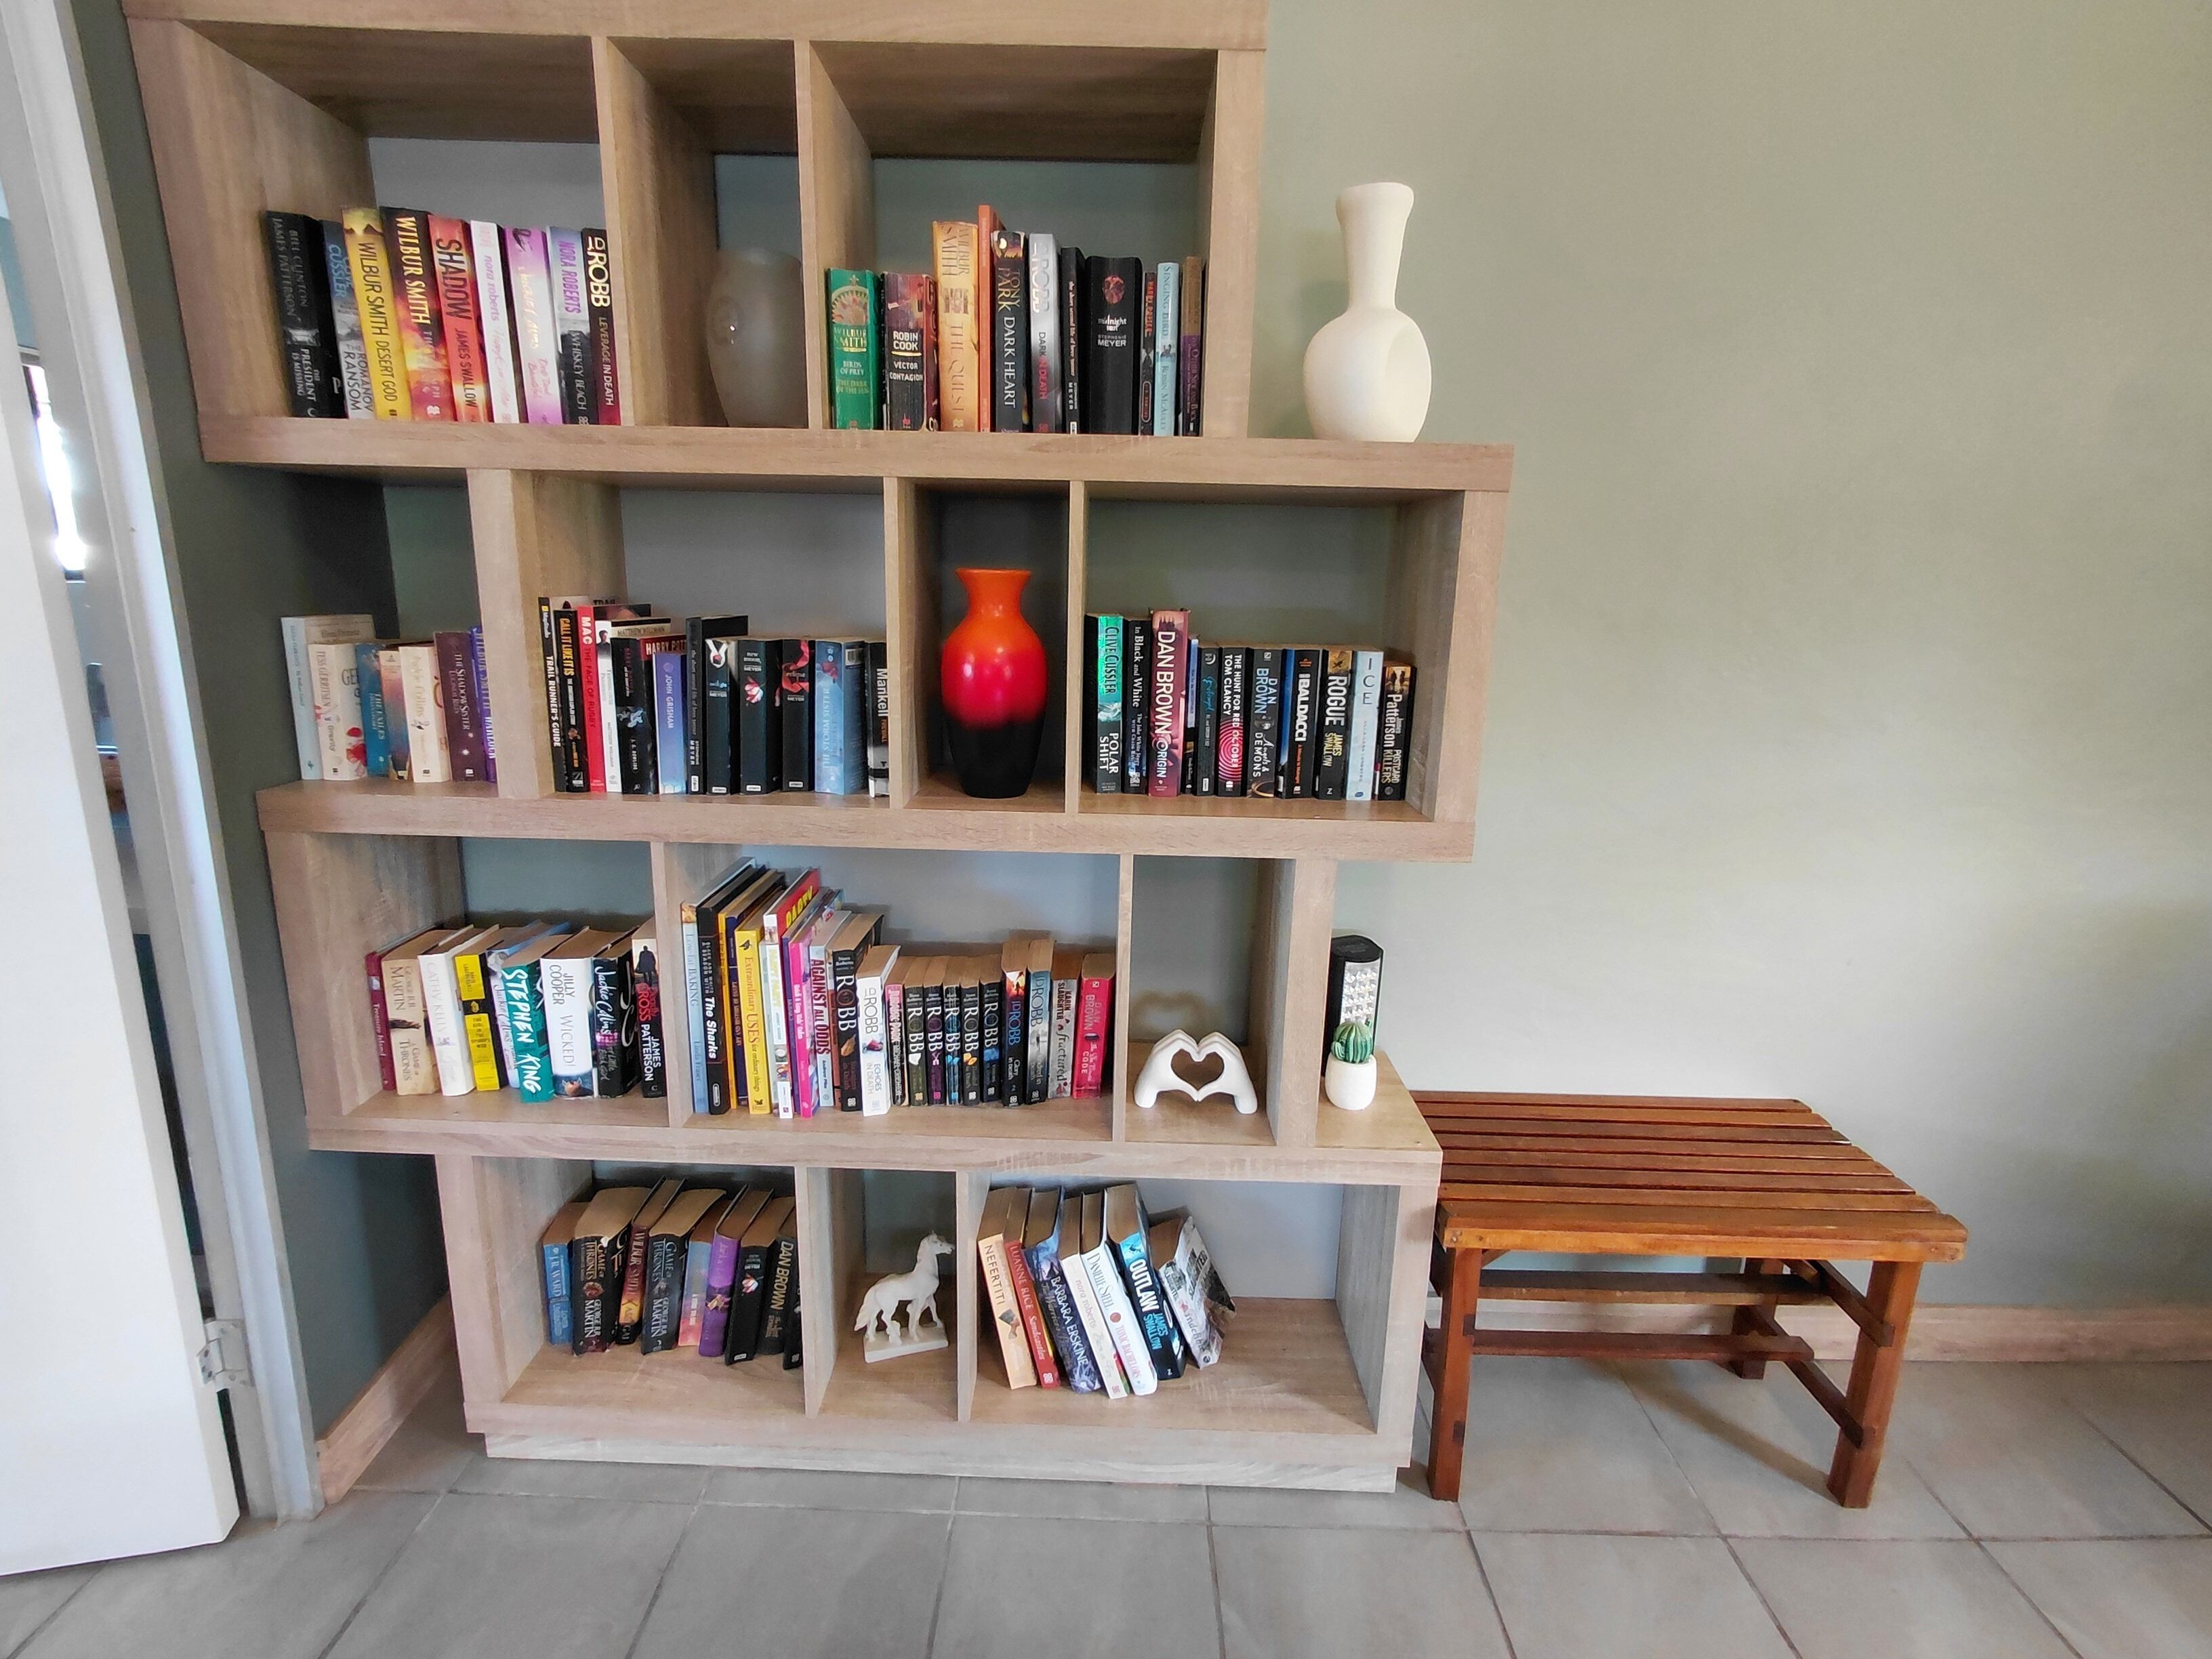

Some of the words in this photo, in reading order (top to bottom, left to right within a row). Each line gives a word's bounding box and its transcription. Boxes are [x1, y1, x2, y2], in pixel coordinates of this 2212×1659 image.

[396, 217, 424, 276] WILBUR
[559, 241, 576, 270] NORA
[941, 226, 958, 276] SMITH
[958, 228, 970, 275] WILBUR
[329, 244, 347, 298] CUSSLER
[358, 243, 380, 292] WILBUR
[436, 239, 472, 320] SHADOW
[485, 255, 494, 280] nora
[587, 252, 611, 308] ROBB
[405, 279, 431, 325] SMITH
[489, 281, 499, 321] roberts
[562, 272, 581, 314] ROBERTS
[998, 267, 1010, 312] PARK
[367, 296, 386, 336] SMITH
[455, 328, 470, 360] JAMES
[572, 332, 585, 377] WHISKEY
[599, 317, 611, 362] LEVERAGE
[893, 331, 918, 341] ROBIN
[893, 341, 918, 351] COOK
[1004, 316, 1016, 358] DARK
[1038, 331, 1046, 356] DARK
[301, 348, 316, 402] PRESIDENT
[376, 341, 393, 377] DESERT
[602, 364, 611, 375] IN
[889, 372, 923, 381] CONTAGION
[894, 361, 918, 369] VECTOR
[344, 351, 364, 411] RANSOM
[381, 380, 398, 402] GOD
[461, 360, 478, 408] SWALLOW
[604, 376, 614, 406] DEATH
[949, 359, 964, 412] QUEST
[1004, 361, 1016, 409] HEART
[1038, 368, 1048, 400] DEATH
[558, 617, 571, 635] CALL
[579, 615, 593, 646] MAC
[1105, 626, 1120, 654] CLIVE
[546, 655, 555, 678] TRAIL
[583, 647, 592, 663] THE
[1134, 635, 1144, 662] Black
[1157, 632, 1176, 668] DAN
[1224, 655, 1233, 675] TOM
[1233, 654, 1242, 669] THE
[586, 687, 594, 698] OF
[665, 675, 673, 696] JOHN
[877, 668, 889, 718] Mankell
[1105, 655, 1120, 694] CUSSLER
[1132, 677, 1143, 708] White
[1233, 671, 1242, 693] HUNT
[1254, 668, 1269, 714] BROWN
[1268, 678, 1278, 704] DAN
[548, 680, 558, 720] RUNNER'S
[822, 687, 830, 716] SISTER
[1155, 671, 1174, 735] BROWN
[1223, 677, 1232, 715] CLANCY
[1233, 696, 1241, 710] FOR
[1295, 678, 1311, 742] BALDACCI
[1324, 675, 1347, 726] ROGUE
[458, 704, 473, 731] SISTER
[552, 722, 560, 747] GUIDE
[822, 719, 831, 751] STORM
[1232, 713, 1240, 727] RED
[1383, 693, 1403, 748] Patterson
[1099, 736, 1109, 771] SHIFT
[1109, 733, 1119, 775] POLAR
[1156, 739, 1168, 778] ORIGIN
[1231, 729, 1240, 767] OCTOBER
[1252, 732, 1263, 778] DEMONS
[1322, 733, 1334, 767] SWALLOW
[1332, 733, 1343, 756] JAMES
[1381, 750, 1393, 784] KILLERS
[390, 966, 405, 1011] MARTIN
[426, 962, 442, 1002] CATHY
[549, 964, 565, 1005] COOPER
[563, 973, 575, 998] JILLY
[594, 966, 617, 1002] Jackie
[743, 956, 756, 1012] Extraordinary
[810, 958, 827, 1008] AGAINST
[1057, 982, 1065, 1020] SLAUGHTER
[1064, 990, 1072, 1010] KARIN
[501, 968, 534, 1044] STEPHEN
[595, 1001, 616, 1035] Collins
[636, 983, 651, 1022] CROSS
[687, 967, 699, 1006] BAKING
[693, 1040, 701, 1060] Linda
[704, 996, 716, 1017] The
[836, 976, 856, 1032] ROBB
[864, 997, 878, 1034] ROBB
[1031, 987, 1044, 1027] ROBB
[1085, 994, 1095, 1030] BROWN
[560, 1015, 575, 1067] WICKED!
[705, 1019, 718, 1059] Sharks
[745, 1012, 758, 1043] USES
[815, 1023, 830, 1055] ODDS
[890, 1022, 901, 1042] PARK
[907, 1006, 924, 1051] ROBB
[926, 1006, 943, 1051] ROBB
[964, 1006, 979, 1051] ROBB
[984, 1001, 999, 1048] ROBB
[1008, 1012, 1021, 1046] ROBB
[398, 1038, 415, 1081] THRONES
[641, 1024, 654, 1082] PATTERSON
[652, 1036, 661, 1068] JAMES
[751, 1052, 760, 1075] ordinary
[867, 1063, 873, 1071] IN
[516, 1052, 542, 1094] KING
[586, 1241, 594, 1280] THRONES
[630, 1232, 641, 1266] WILBUR
[651, 1240, 663, 1282] THRONES
[665, 1242, 677, 1271] GAME
[779, 1241, 794, 1266] DAN
[551, 1271, 562, 1296] WARD
[771, 1268, 790, 1310] BROWN
[985, 1245, 1006, 1305] NEFERTITI
[1086, 1253, 1108, 1291] DANIELLE
[1098, 1284, 1114, 1311] STEEL
[1129, 1259, 1160, 1313] OUTLAW
[585, 1300, 595, 1338] MARTIN
[651, 1299, 663, 1338] MARTIN
[1010, 1246, 1027, 1286] LUANNE
[1021, 1287, 1033, 1310] RICE
[1029, 1315, 1046, 1360] Sandcastles
[1050, 1277, 1073, 1326] BARBARA
[1067, 1324, 1088, 1366] ERSKINE
[1076, 1279, 1086, 1299] nora
[1082, 1299, 1097, 1328] roberts
[1143, 1314, 1162, 1350] SWALLOW
[1152, 1313, 1168, 1336] JAMES
